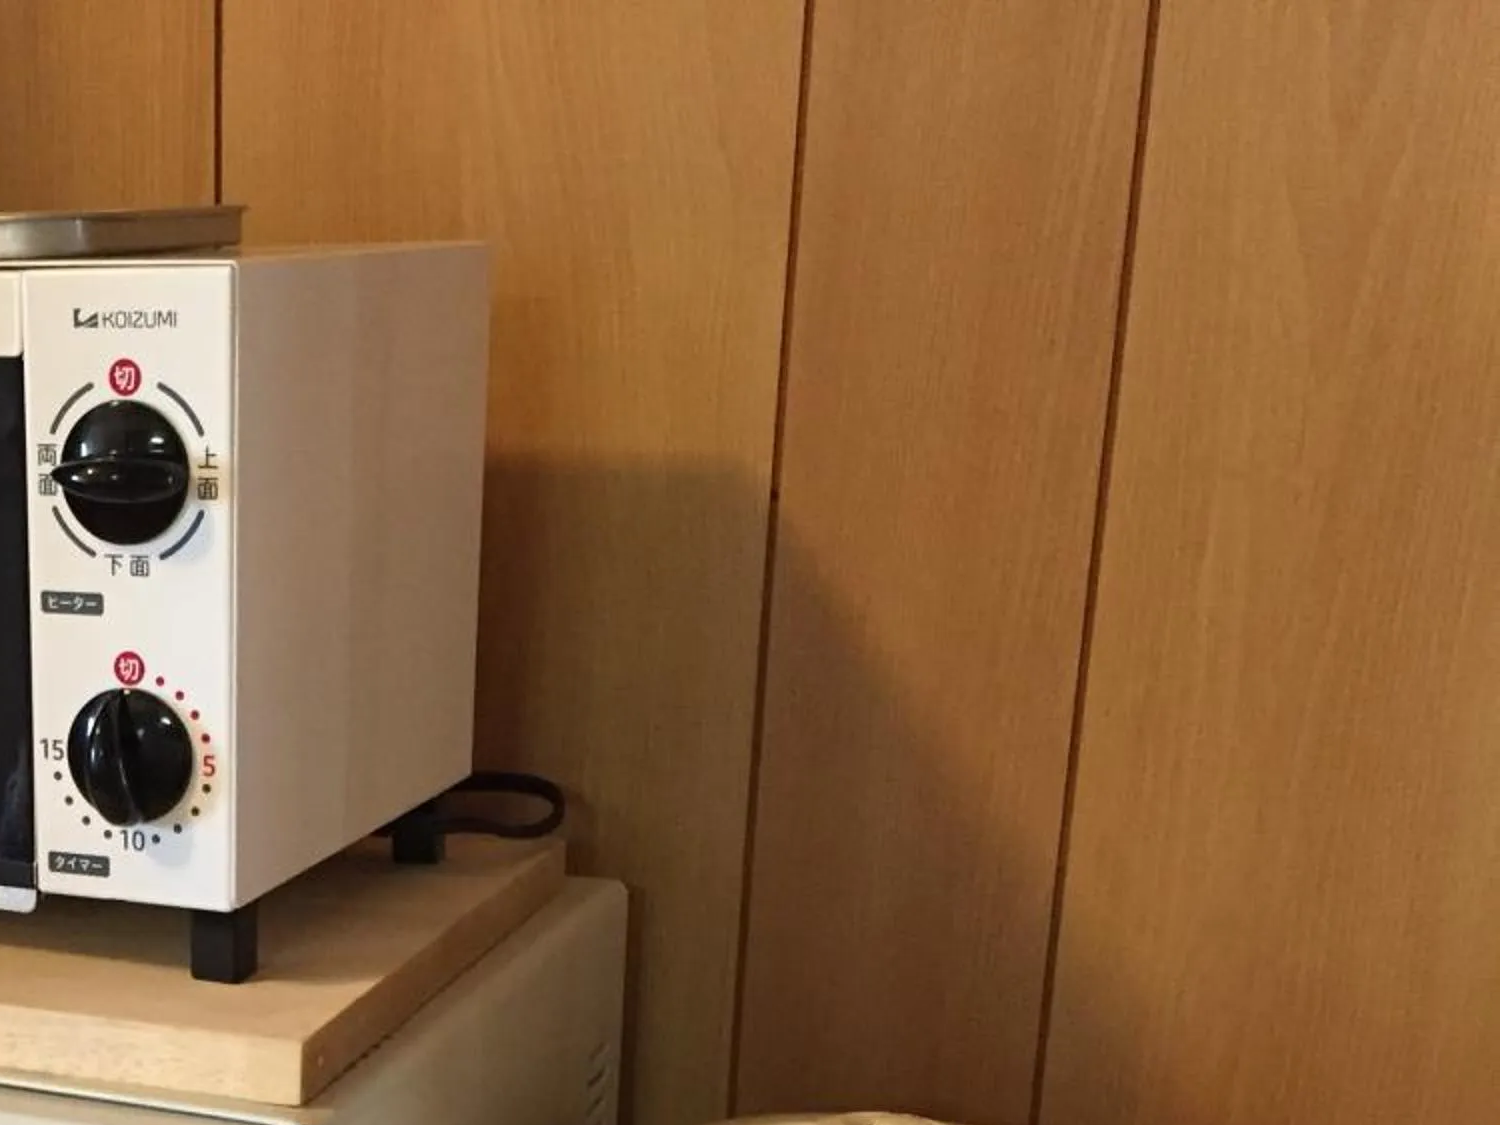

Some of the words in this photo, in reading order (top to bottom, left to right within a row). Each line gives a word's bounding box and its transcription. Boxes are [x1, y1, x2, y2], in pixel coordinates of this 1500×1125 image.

[102, 310, 178, 328] KOIZUMI
[113, 365, 137, 391] 切
[197, 446, 219, 500] 上面
[104, 554, 150, 577] 下面
[46, 594, 99, 611] ヒーター
[117, 658, 140, 681] 切
[40, 738, 65, 760] 15
[203, 755, 216, 777] 5
[120, 829, 145, 851] 10
[54, 855, 104, 871] タイマー
